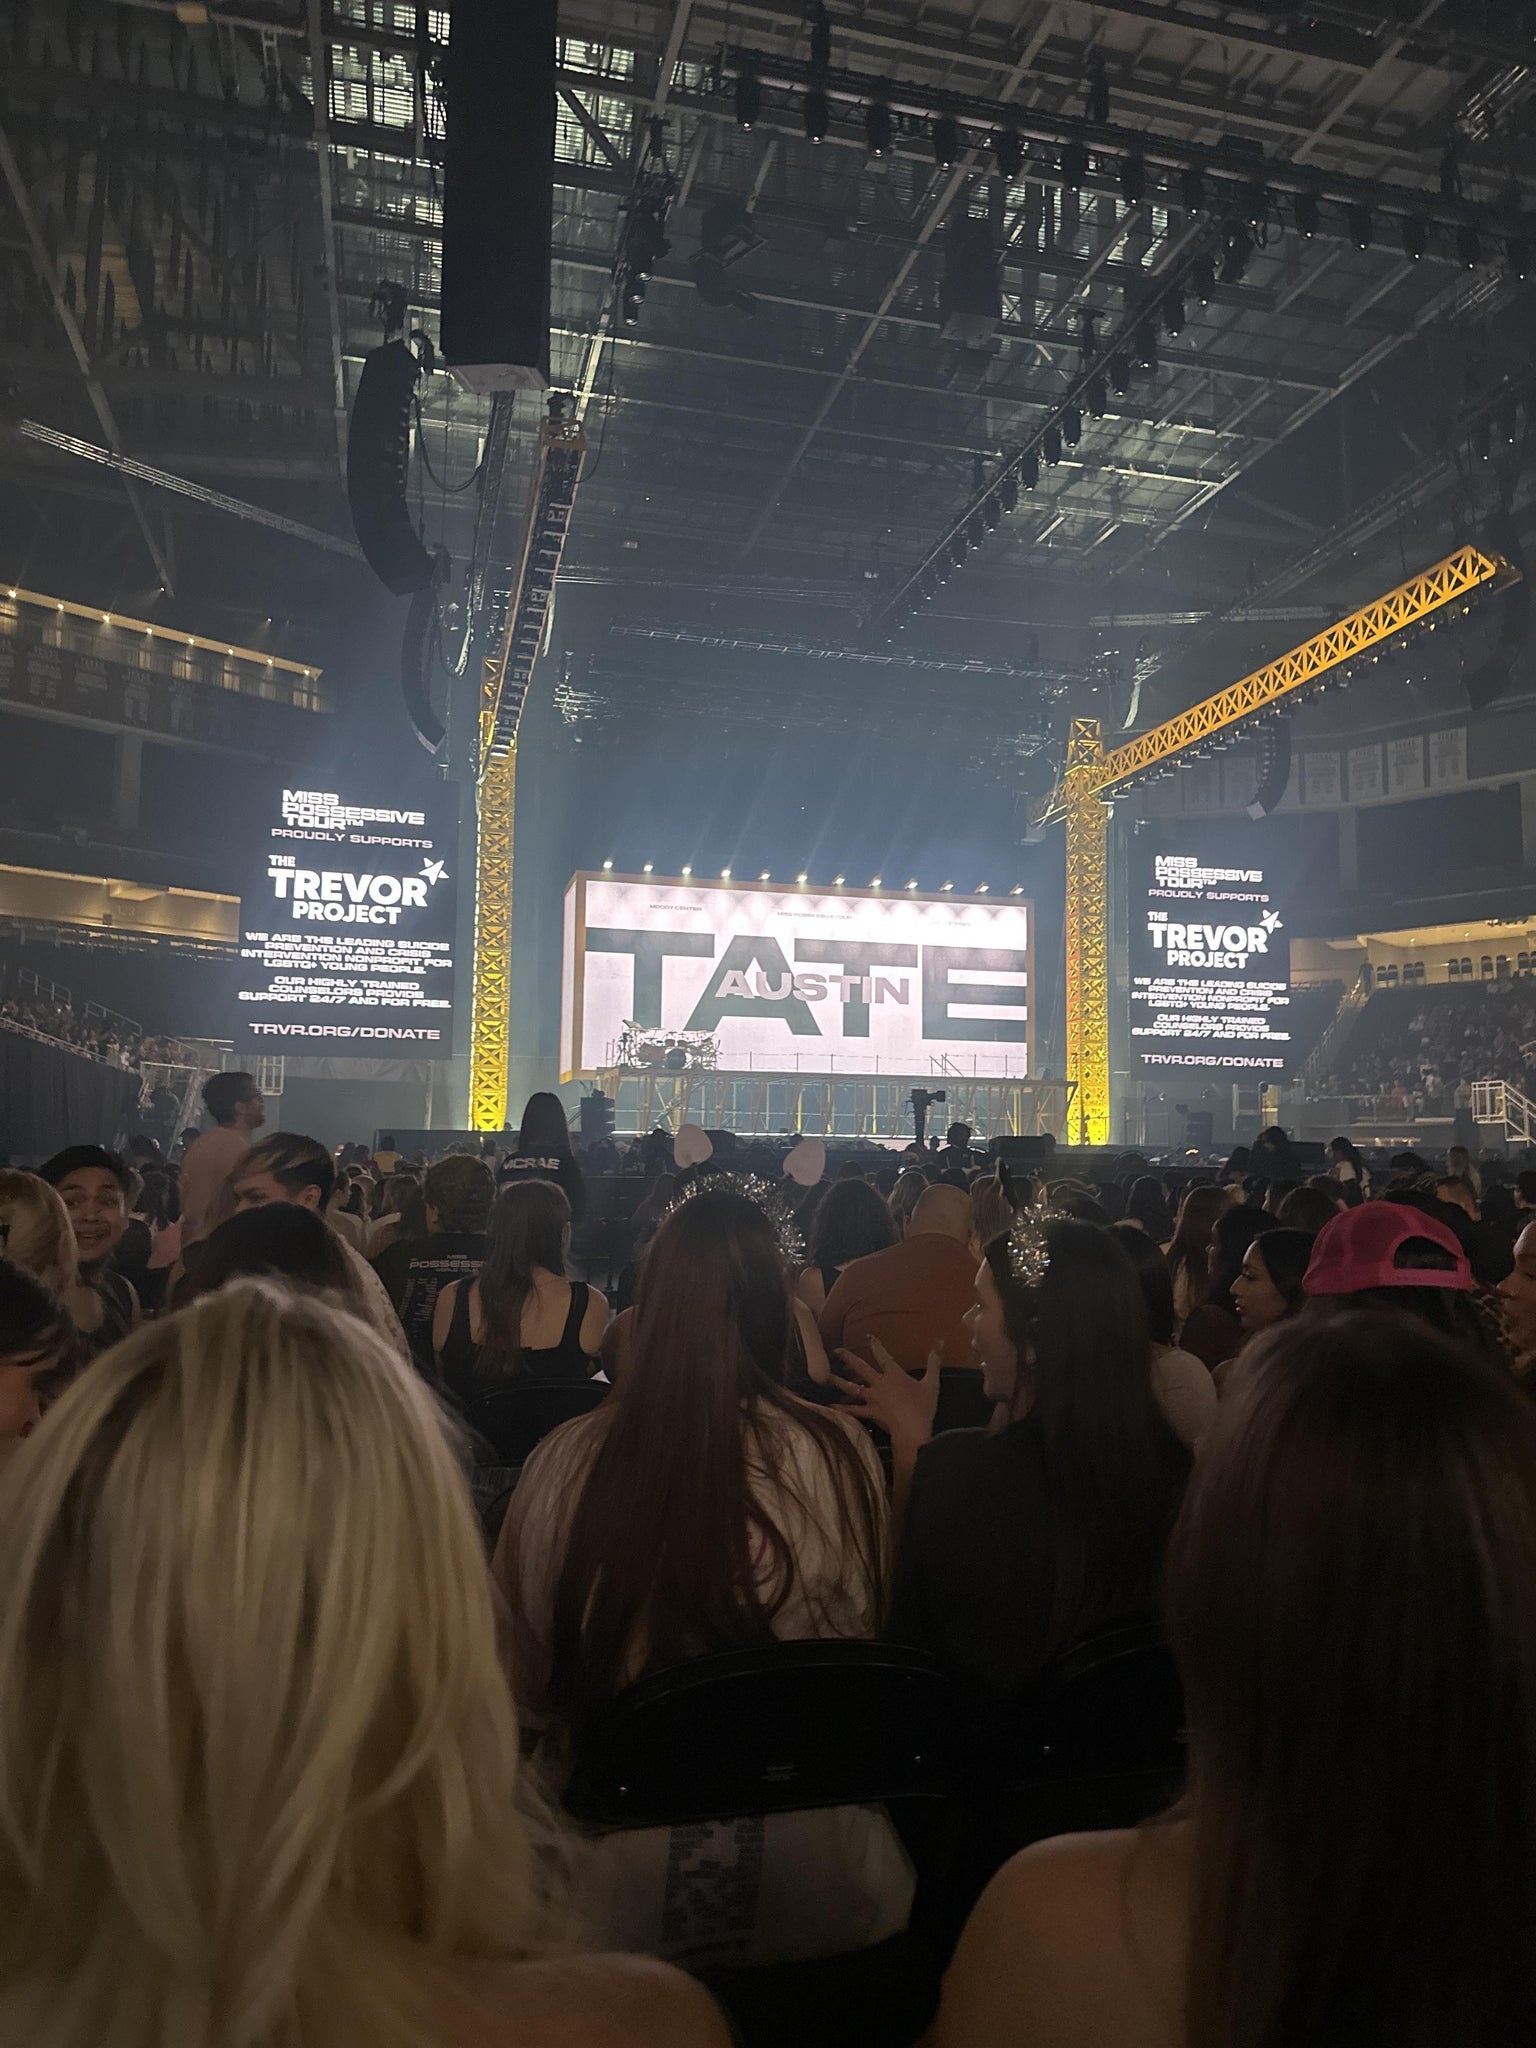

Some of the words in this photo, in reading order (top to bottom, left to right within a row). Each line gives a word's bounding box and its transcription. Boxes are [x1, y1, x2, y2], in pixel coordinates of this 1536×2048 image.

[283, 790, 339, 805] MISS
[282, 802, 425, 825] POSSESSIVE
[272, 828, 345, 842] PROUDLY
[350, 834, 433, 848] SUPPORTS
[268, 855, 296, 867] THE
[1155, 856, 1197, 867] MISS
[1155, 867, 1263, 882] POSSESSIVE
[268, 868, 428, 907] TREVOR
[1149, 889, 1203, 899] PROUDLY
[1206, 892, 1269, 902] SUPPORTS
[293, 901, 401, 924] PROJECT
[1147, 911, 1168, 922] THE
[245, 932, 268, 941] WE
[271, 934, 301, 943] ARE
[304, 935, 334, 944] THE
[337, 937, 395, 948] LEADING
[398, 940, 449, 950] SUICIDE
[1147, 923, 1268, 953] TREVOR
[265, 942, 350, 953] PREVENTION
[353, 947, 385, 955] AND
[388, 949, 431, 958] CRISIS
[241, 949, 342, 961] INTERVENTION
[345, 955, 422, 965] NONPROFIT
[425, 958, 452, 967] FOR
[264, 959, 317, 969] LGBTQ+
[320, 961, 368, 971] YOUNG
[1167, 950, 1249, 969] PROJECT
[274, 976, 305, 985] OUR
[308, 978, 357, 988] HIGHLY
[360, 981, 419, 990] TRAINED
[585, 927, 1027, 1043] TATE
[715, 970, 909, 1005] AUSTIN
[1201, 980, 1245, 989] LEADING
[269, 985, 363, 996] COUNSELORS
[366, 989, 424, 998] PROVIDE
[1148, 986, 1213, 995] PREVENTION
[1215, 988, 1238, 996] AND
[239, 991, 306, 1002] SUPPORT
[310, 995, 346, 1004] 24/7
[349, 996, 378, 1005] AND
[382, 997, 410, 1006] FOR
[1132, 992, 1206, 1001] INTERVENTION
[1208, 995, 1265, 1004] NONPROFIT
[1267, 997, 1289, 1005] FOR
[1190, 1002, 1225, 1010] YOUNG
[1157, 1014, 1180, 1022] OUR
[1182, 1015, 1219, 1023] HIGHLY
[1220, 1016, 1265, 1024] TRAINED
[249, 1023, 440, 1039] TRVR.ORG/DONATE
[1132, 1028, 1181, 1036] SUPPORT
[1153, 1022, 1223, 1031] COUNSELORS
[1141, 1054, 1284, 1068] TRVR.ORG/DONATE
